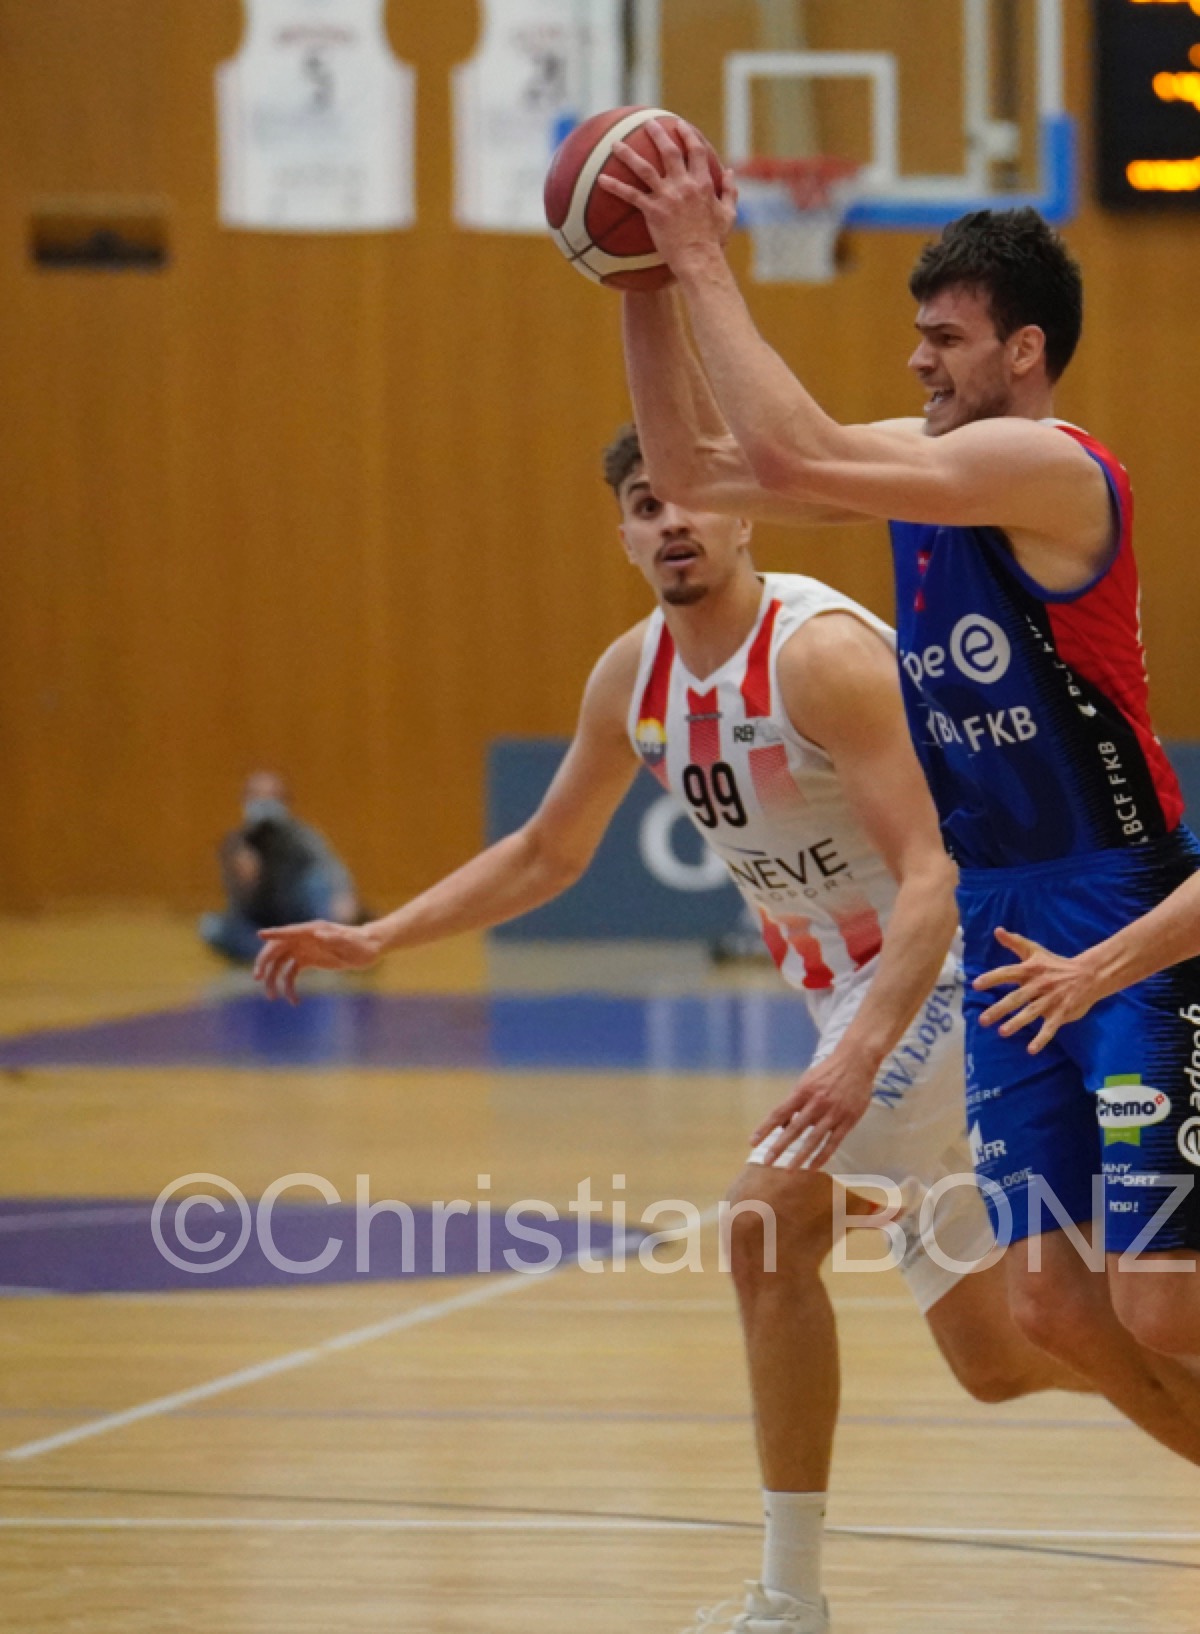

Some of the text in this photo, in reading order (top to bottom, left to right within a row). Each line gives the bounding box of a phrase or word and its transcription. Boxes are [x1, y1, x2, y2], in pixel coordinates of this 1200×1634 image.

[900, 645, 945, 692] pe
[962, 706, 1038, 752] FKB
[682, 762, 748, 829] 99
[1098, 741, 1144, 836] BCF FKB
